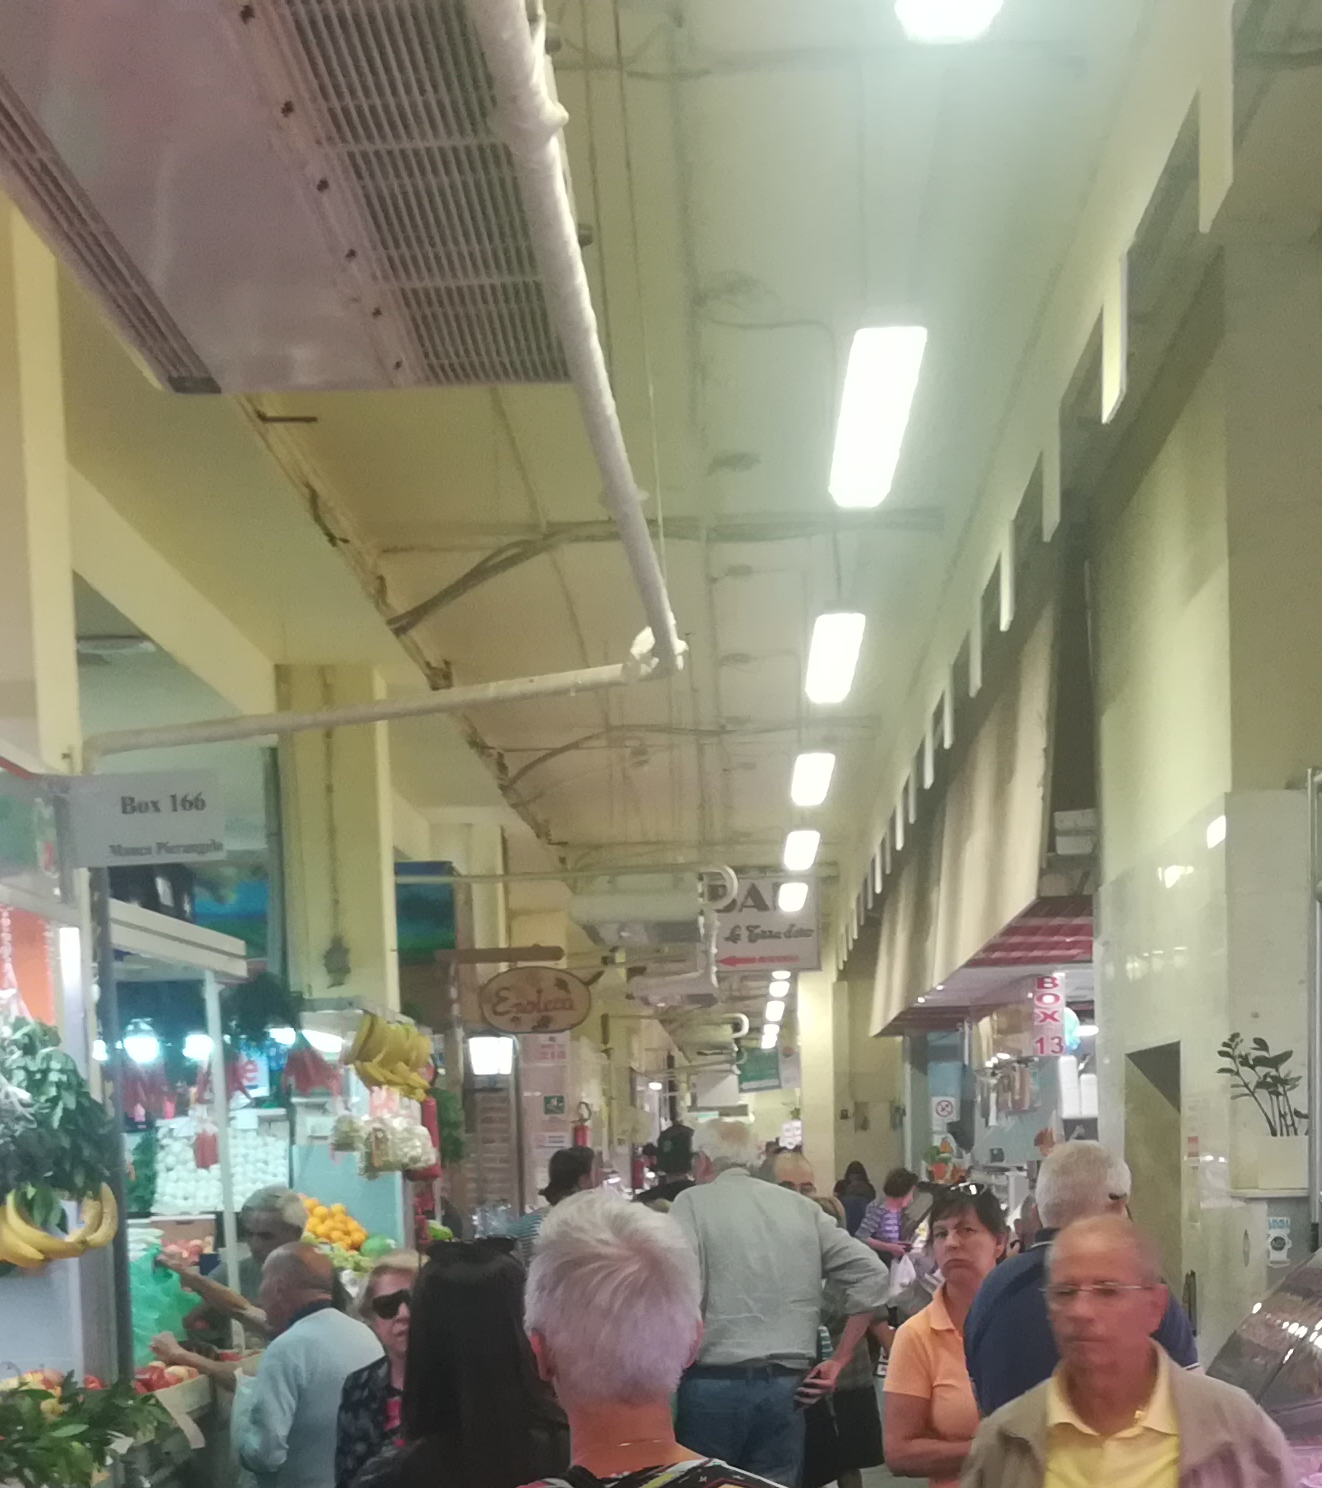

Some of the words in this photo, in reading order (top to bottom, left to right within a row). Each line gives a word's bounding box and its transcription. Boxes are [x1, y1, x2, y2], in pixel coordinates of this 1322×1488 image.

[120, 796, 162, 815] Box
[169, 792, 207, 812] 166
[1036, 975, 1061, 1023] BOX
[1035, 1035, 1064, 1055] 13
